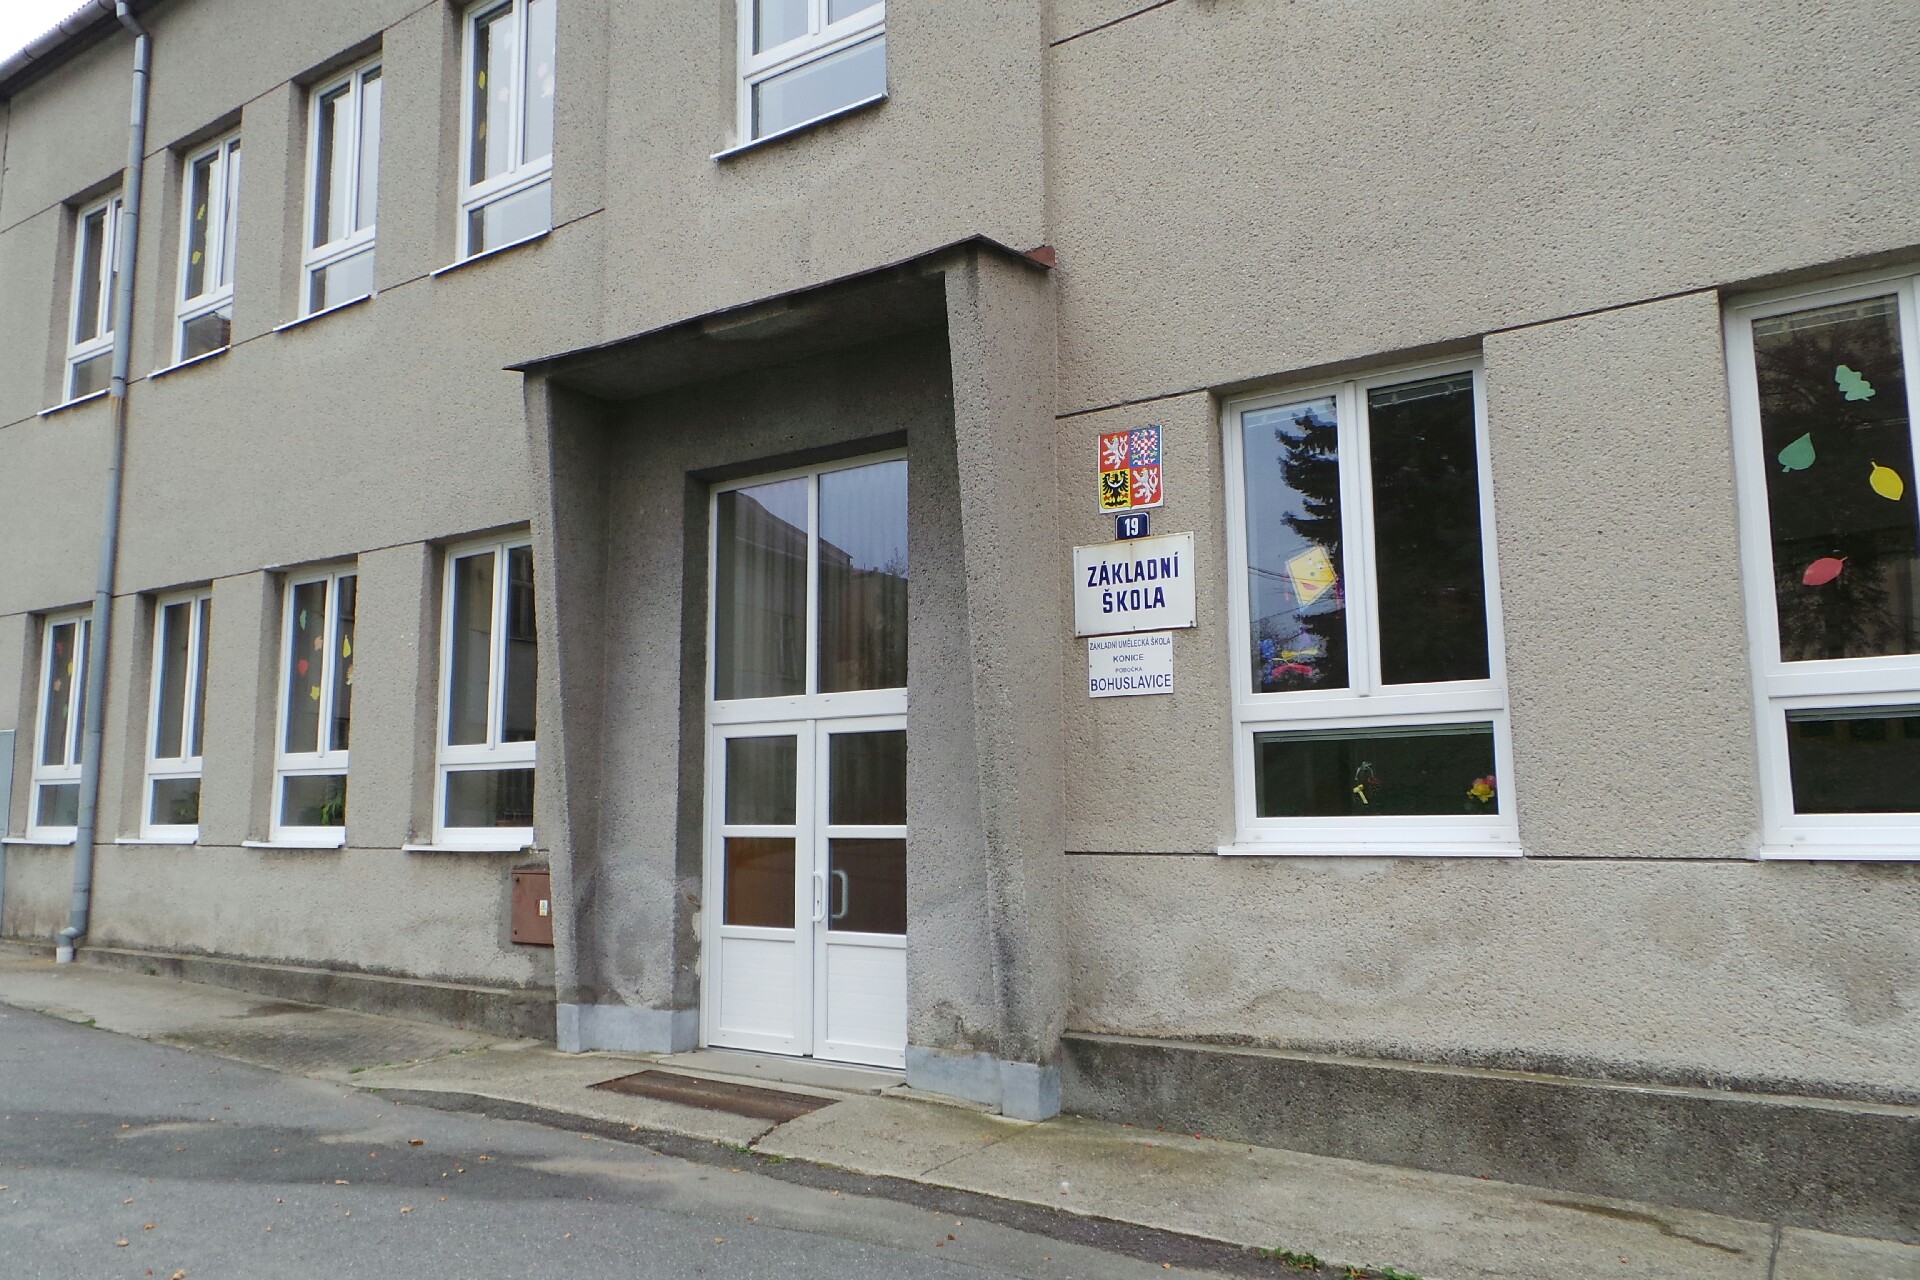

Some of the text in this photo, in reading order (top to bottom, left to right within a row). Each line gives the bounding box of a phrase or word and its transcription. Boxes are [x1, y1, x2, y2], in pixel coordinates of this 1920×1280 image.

[1124, 517, 1139, 536] 19
[1087, 551, 1179, 587] ZÁKLADNÍ
[1102, 587, 1165, 613] ŠKOLA
[1150, 637, 1171, 646] ŠKOLA
[1112, 654, 1144, 663] KONICE
[1090, 674, 1171, 691] BOHUSLAVICE
